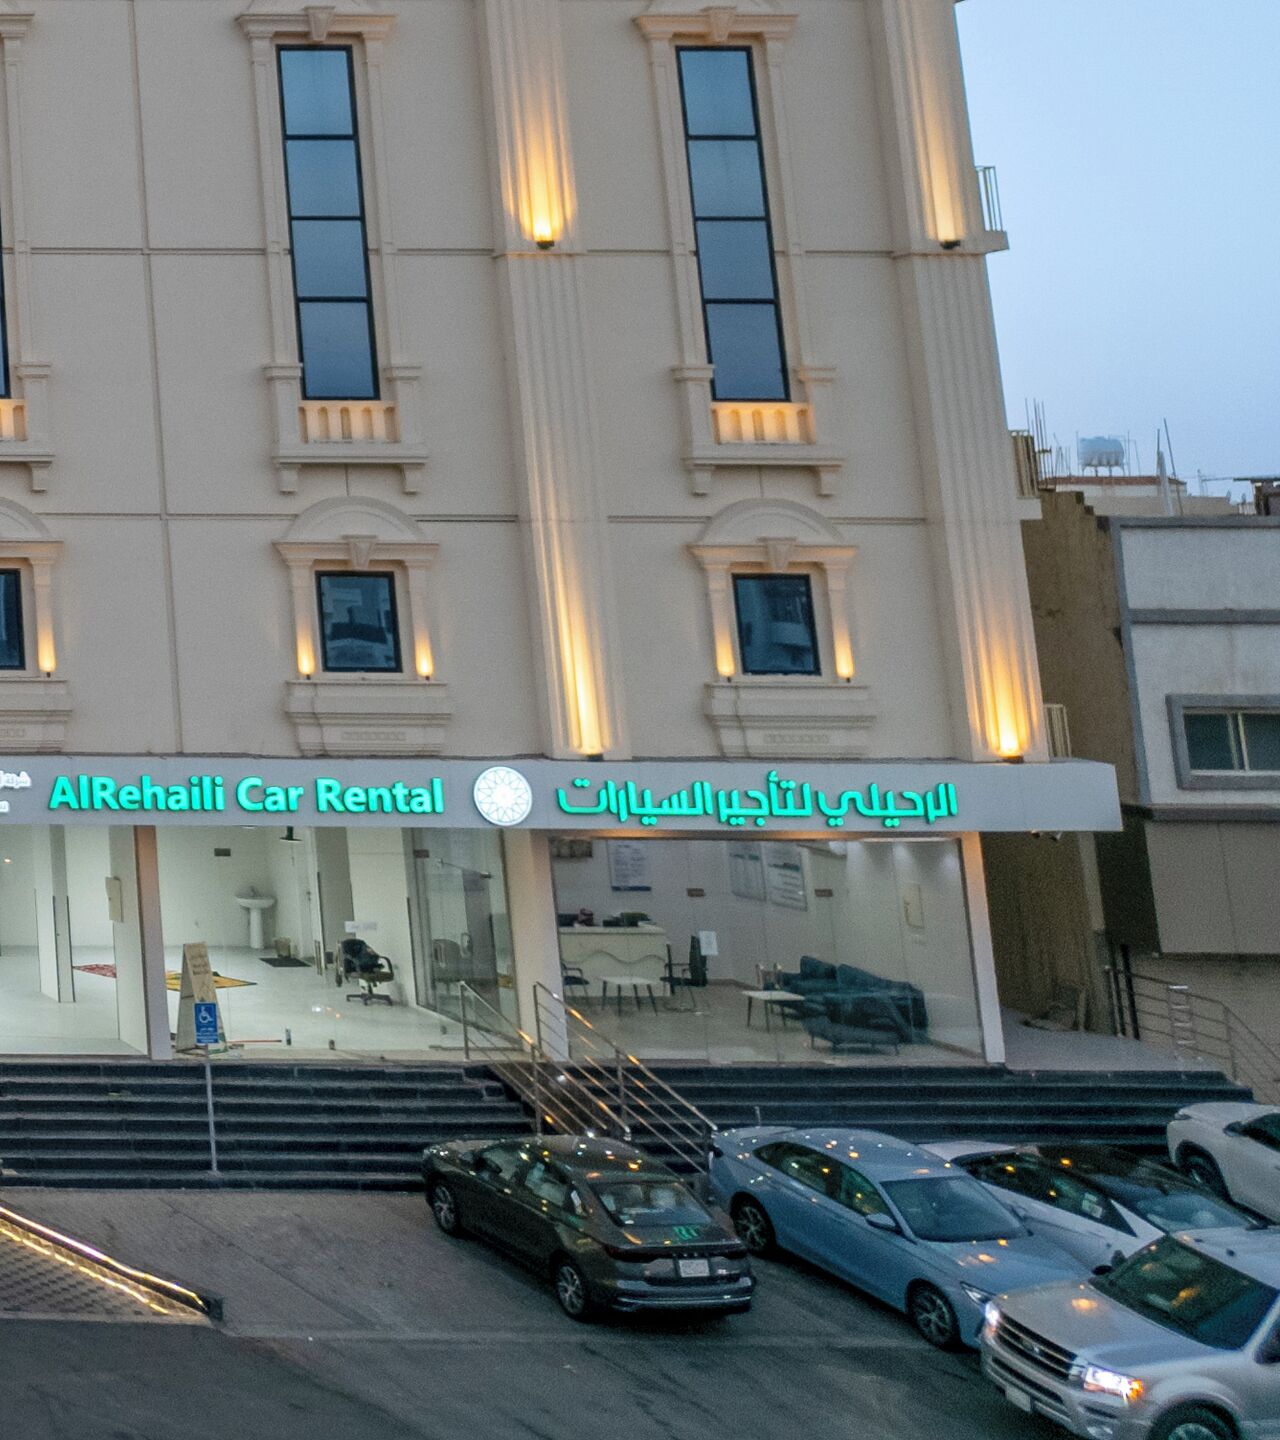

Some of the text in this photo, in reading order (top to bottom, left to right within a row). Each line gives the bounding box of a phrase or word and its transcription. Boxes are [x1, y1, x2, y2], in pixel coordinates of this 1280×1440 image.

[47, 773, 446, 815] AlRehaili Car Rental
[556, 769, 959, 828] الرحيلي لتأجير السيارات
